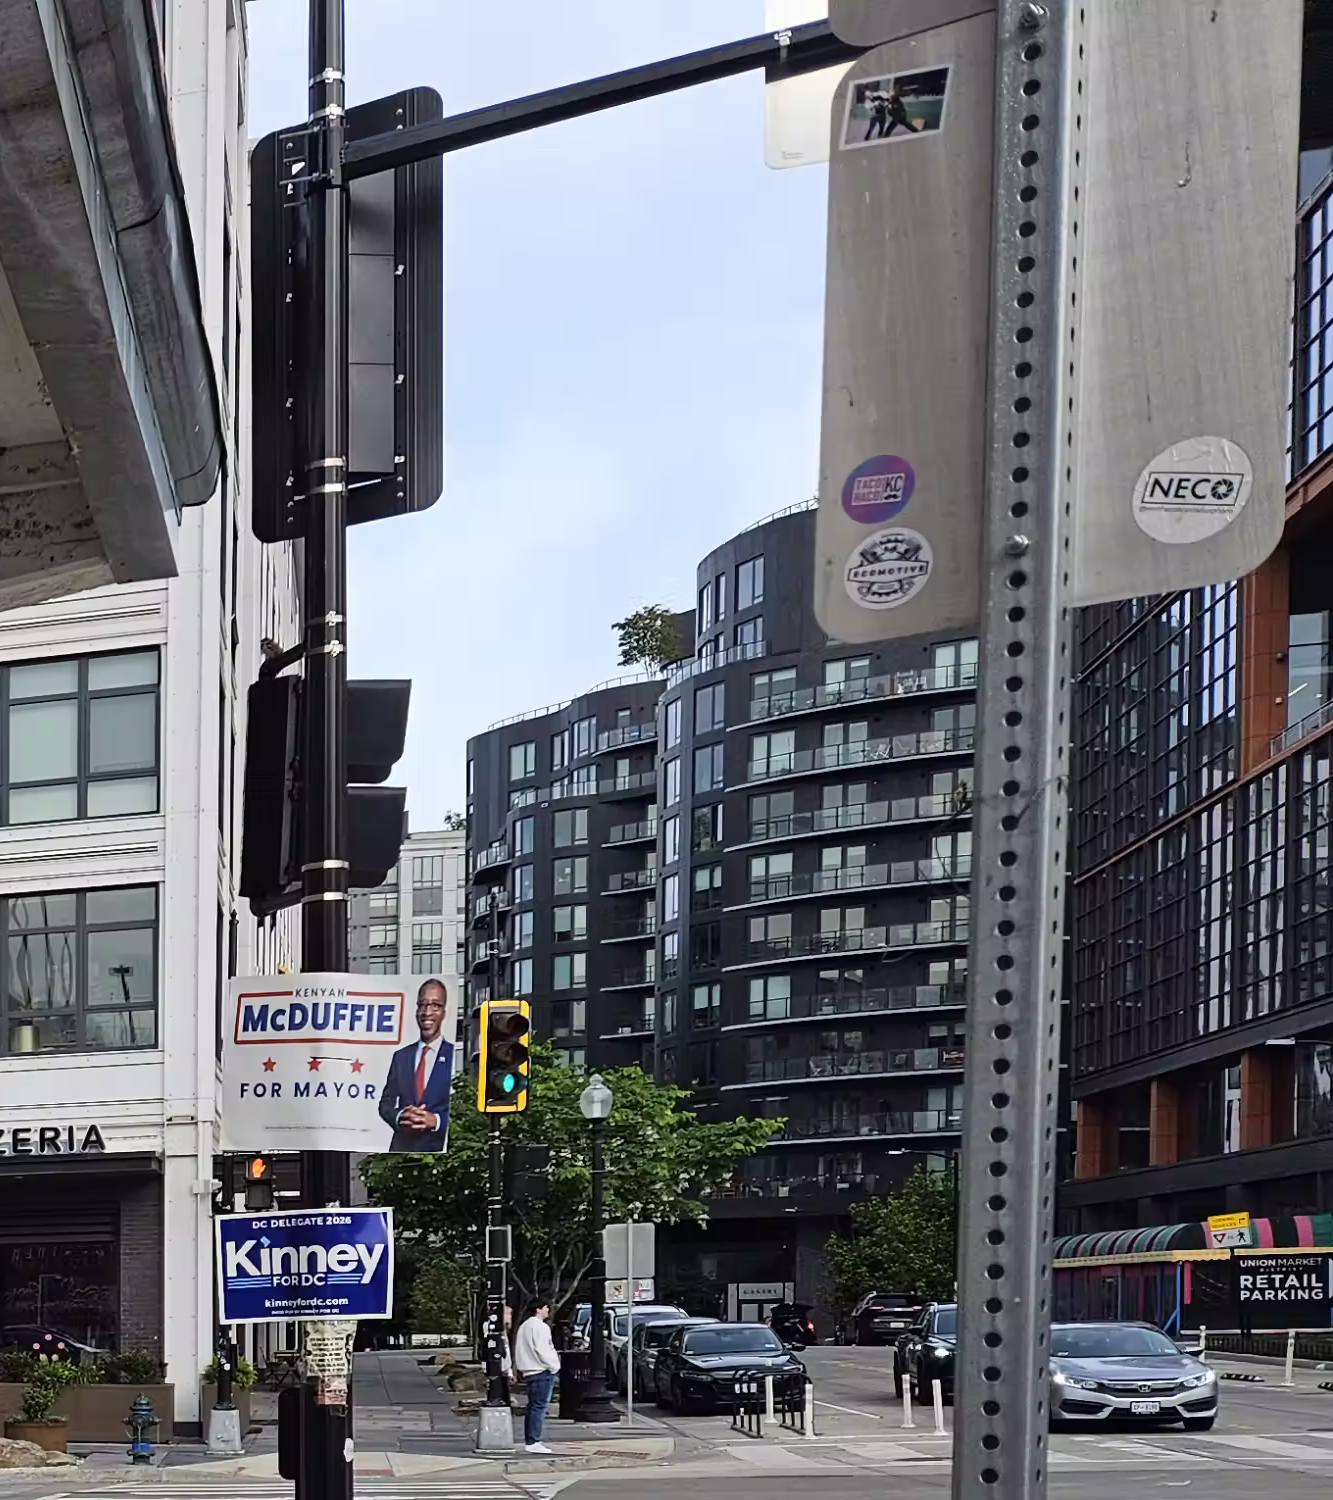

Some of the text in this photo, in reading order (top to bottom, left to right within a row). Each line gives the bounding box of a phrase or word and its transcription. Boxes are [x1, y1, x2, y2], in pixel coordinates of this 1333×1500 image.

[884, 475, 903, 493] KC
[1149, 477, 1235, 500] NECO
[853, 564, 925, 579] ECOMOTIVE
[295, 988, 346, 998] KENYAN
[242, 1002, 396, 1033] McDUFFIE
[240, 1082, 376, 1100] FOR MAYOR
[252, 1216, 352, 1229] DC DELEGATE 2026
[225, 1236, 385, 1284] Kinney
[1239, 1257, 1323, 1267] UNION MARKET
[273, 1274, 326, 1287] FOR DC
[1239, 1273, 1324, 1289] RETAIL
[1239, 1289, 1324, 1301] PARKING
[264, 1297, 349, 1309] kinneyfordc.com
